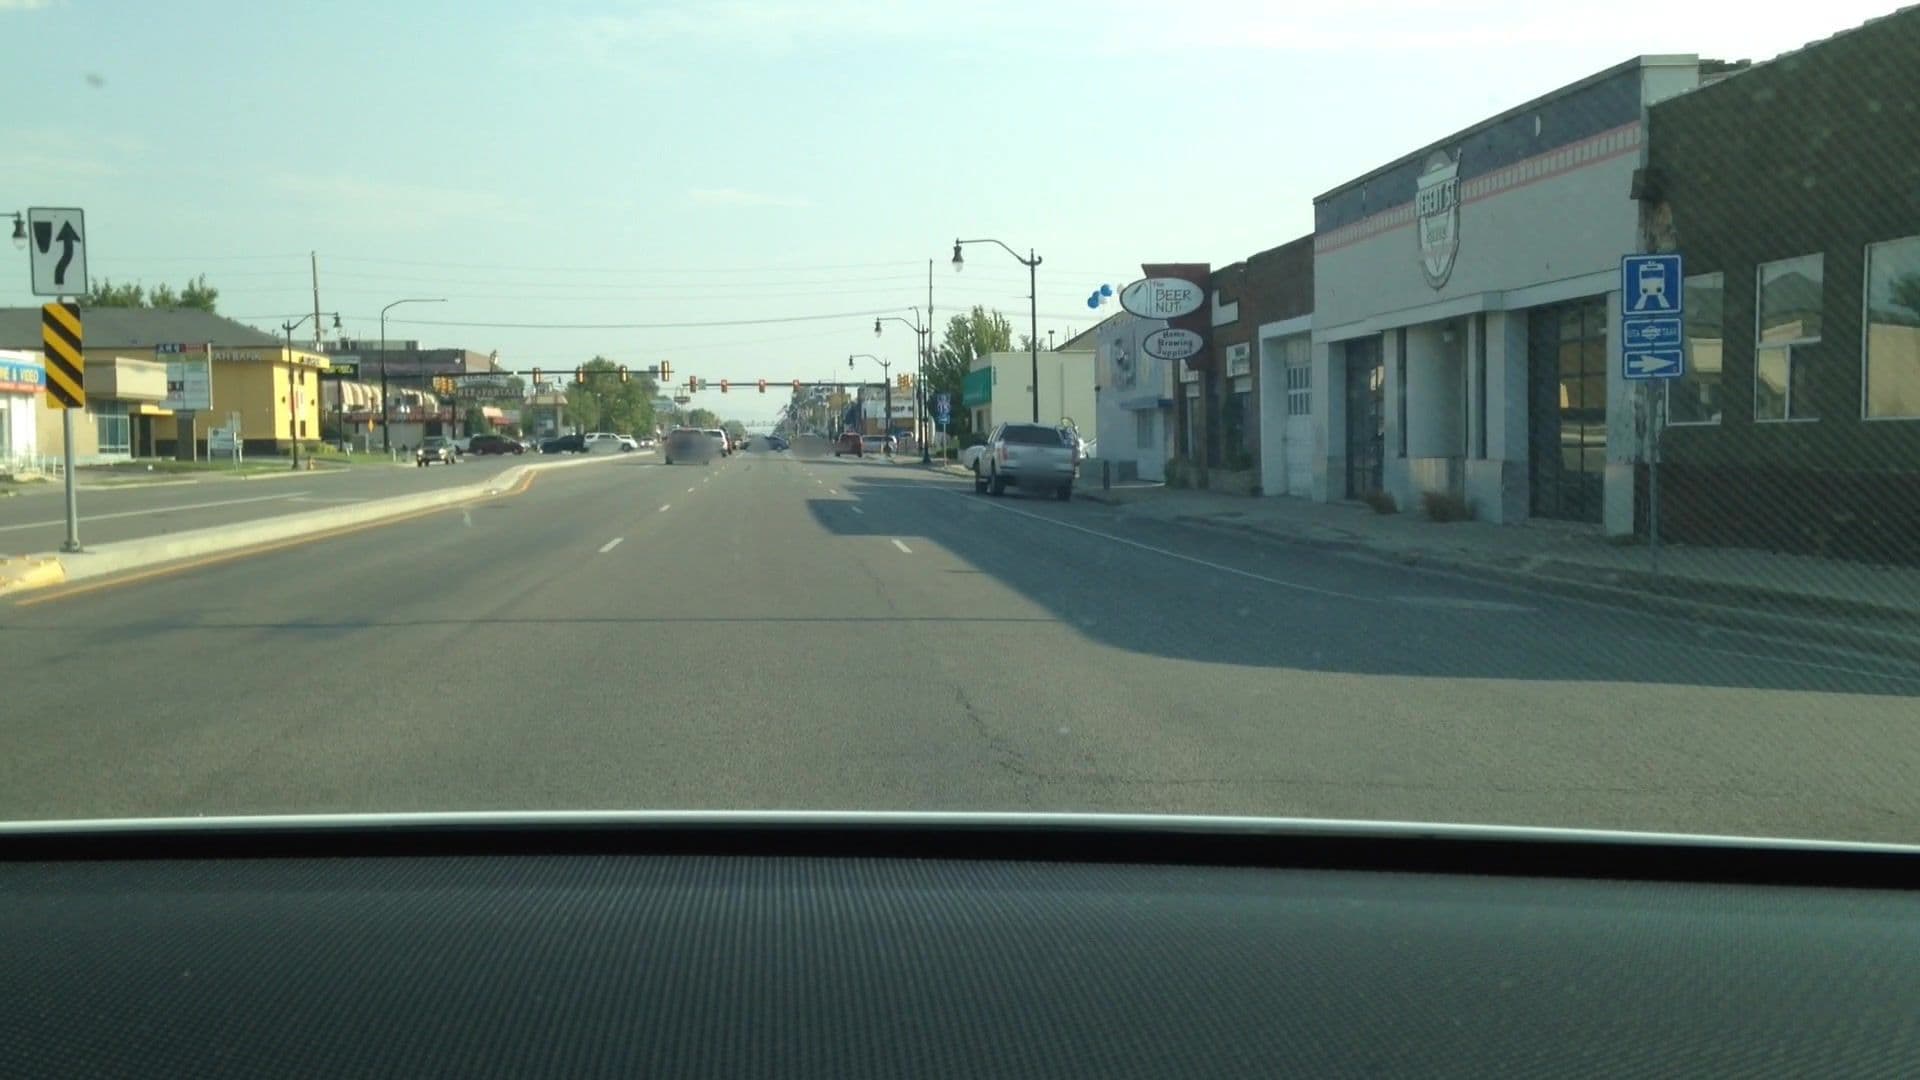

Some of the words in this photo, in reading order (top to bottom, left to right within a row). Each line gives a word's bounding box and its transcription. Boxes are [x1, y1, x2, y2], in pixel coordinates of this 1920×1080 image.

[1155, 288, 1192, 302] BEER
[1155, 302, 1180, 313] NUT
[20, 368, 39, 384] VIDEO
